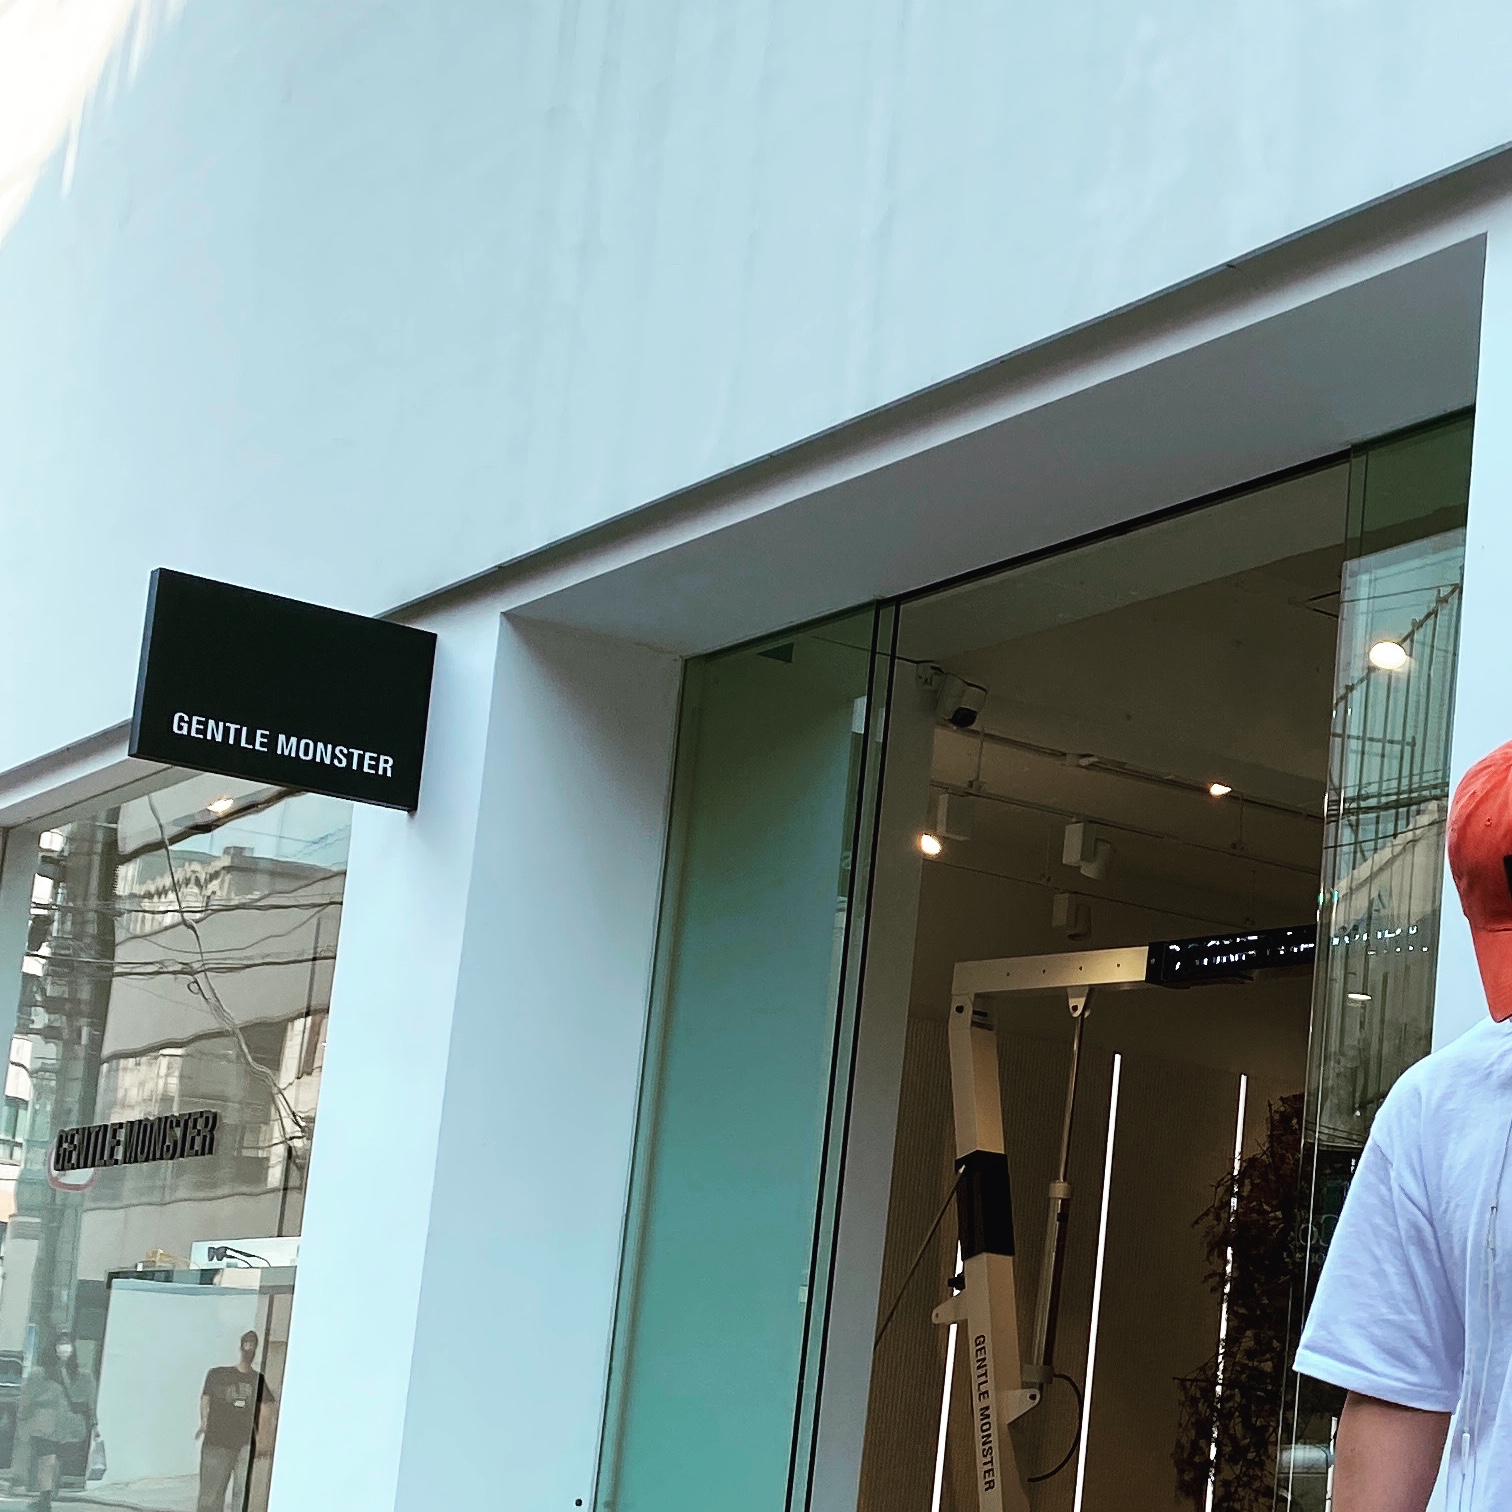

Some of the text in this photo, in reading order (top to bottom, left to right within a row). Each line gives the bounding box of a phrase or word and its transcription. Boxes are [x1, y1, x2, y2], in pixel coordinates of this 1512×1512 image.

[172, 712, 394, 778] GENTLE MONSTER
[54, 1110, 219, 1171] GENTLE MONSTER
[974, 1334, 995, 1492] GENTLE MONSTER
